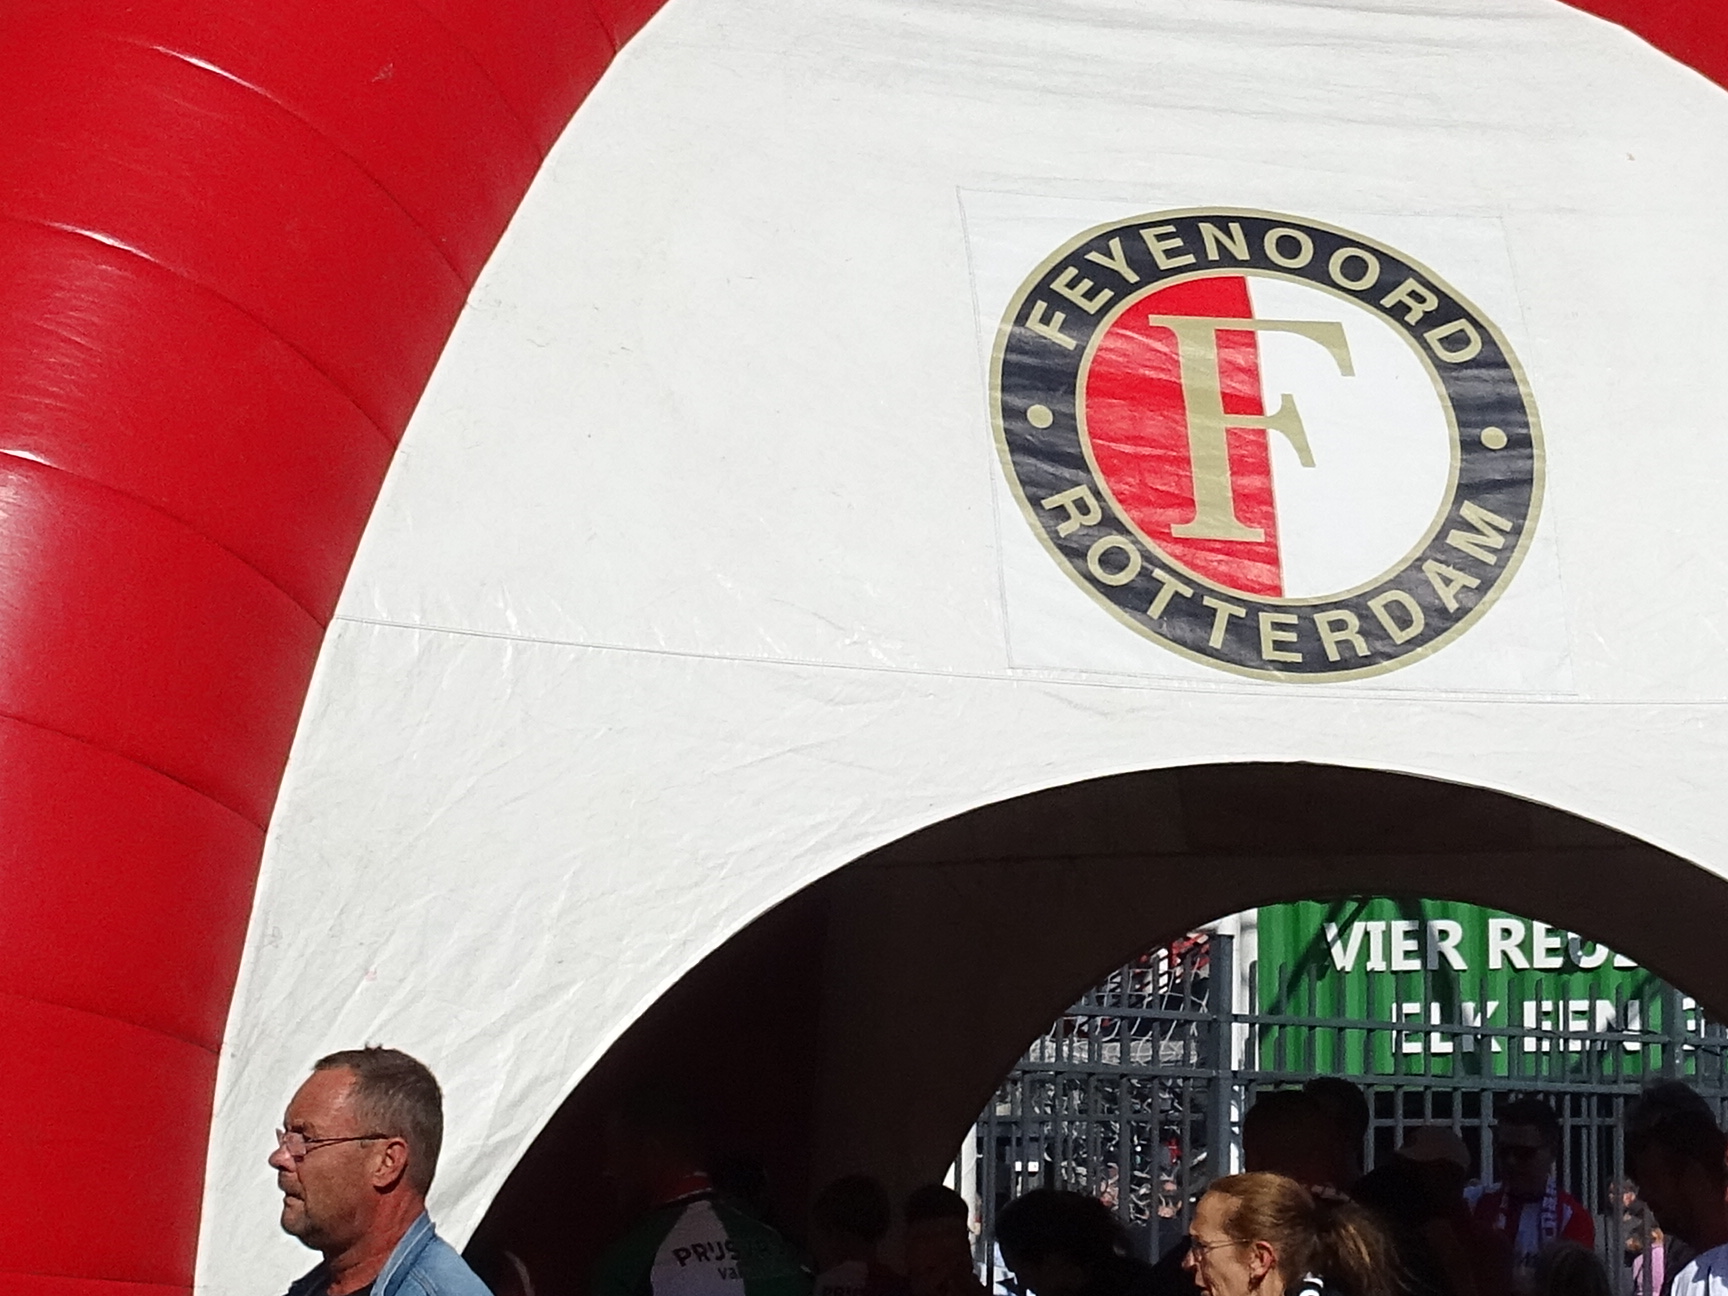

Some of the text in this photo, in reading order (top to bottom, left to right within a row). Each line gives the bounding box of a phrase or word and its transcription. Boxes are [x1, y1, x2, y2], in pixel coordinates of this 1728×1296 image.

[1025, 222, 1482, 364] FEYENOORD
[1148, 314, 1356, 542] F
[1041, 484, 1514, 662] ROTTERDAM
[1324, 917, 1640, 972] VIER REU
